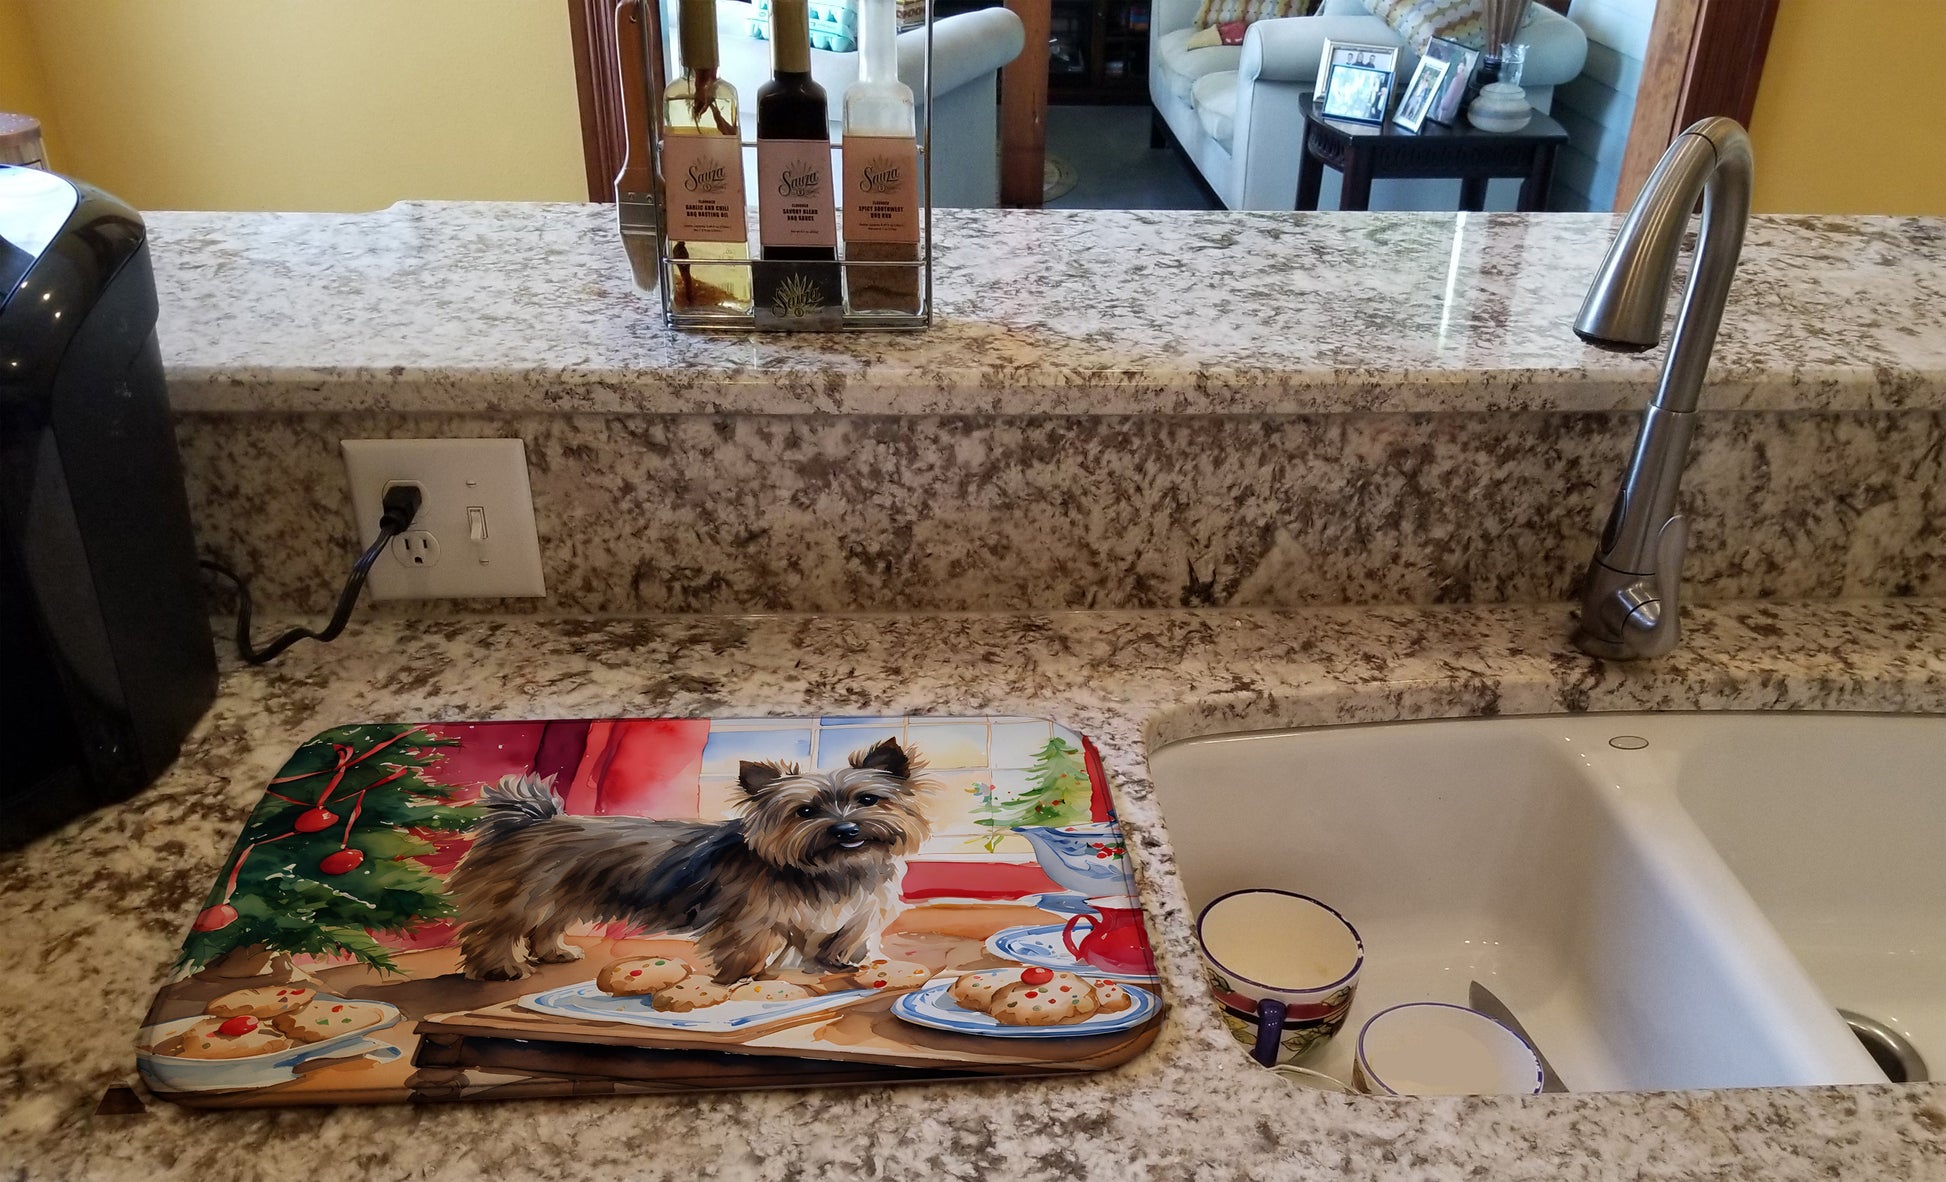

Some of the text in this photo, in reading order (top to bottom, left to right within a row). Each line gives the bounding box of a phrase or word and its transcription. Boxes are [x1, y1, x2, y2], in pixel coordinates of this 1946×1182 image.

[684, 166, 726, 192] Sauza
[778, 170, 820, 197] Sauza
[860, 166, 900, 193] Sauza
[873, 205, 904, 213] SOUTHWEST
